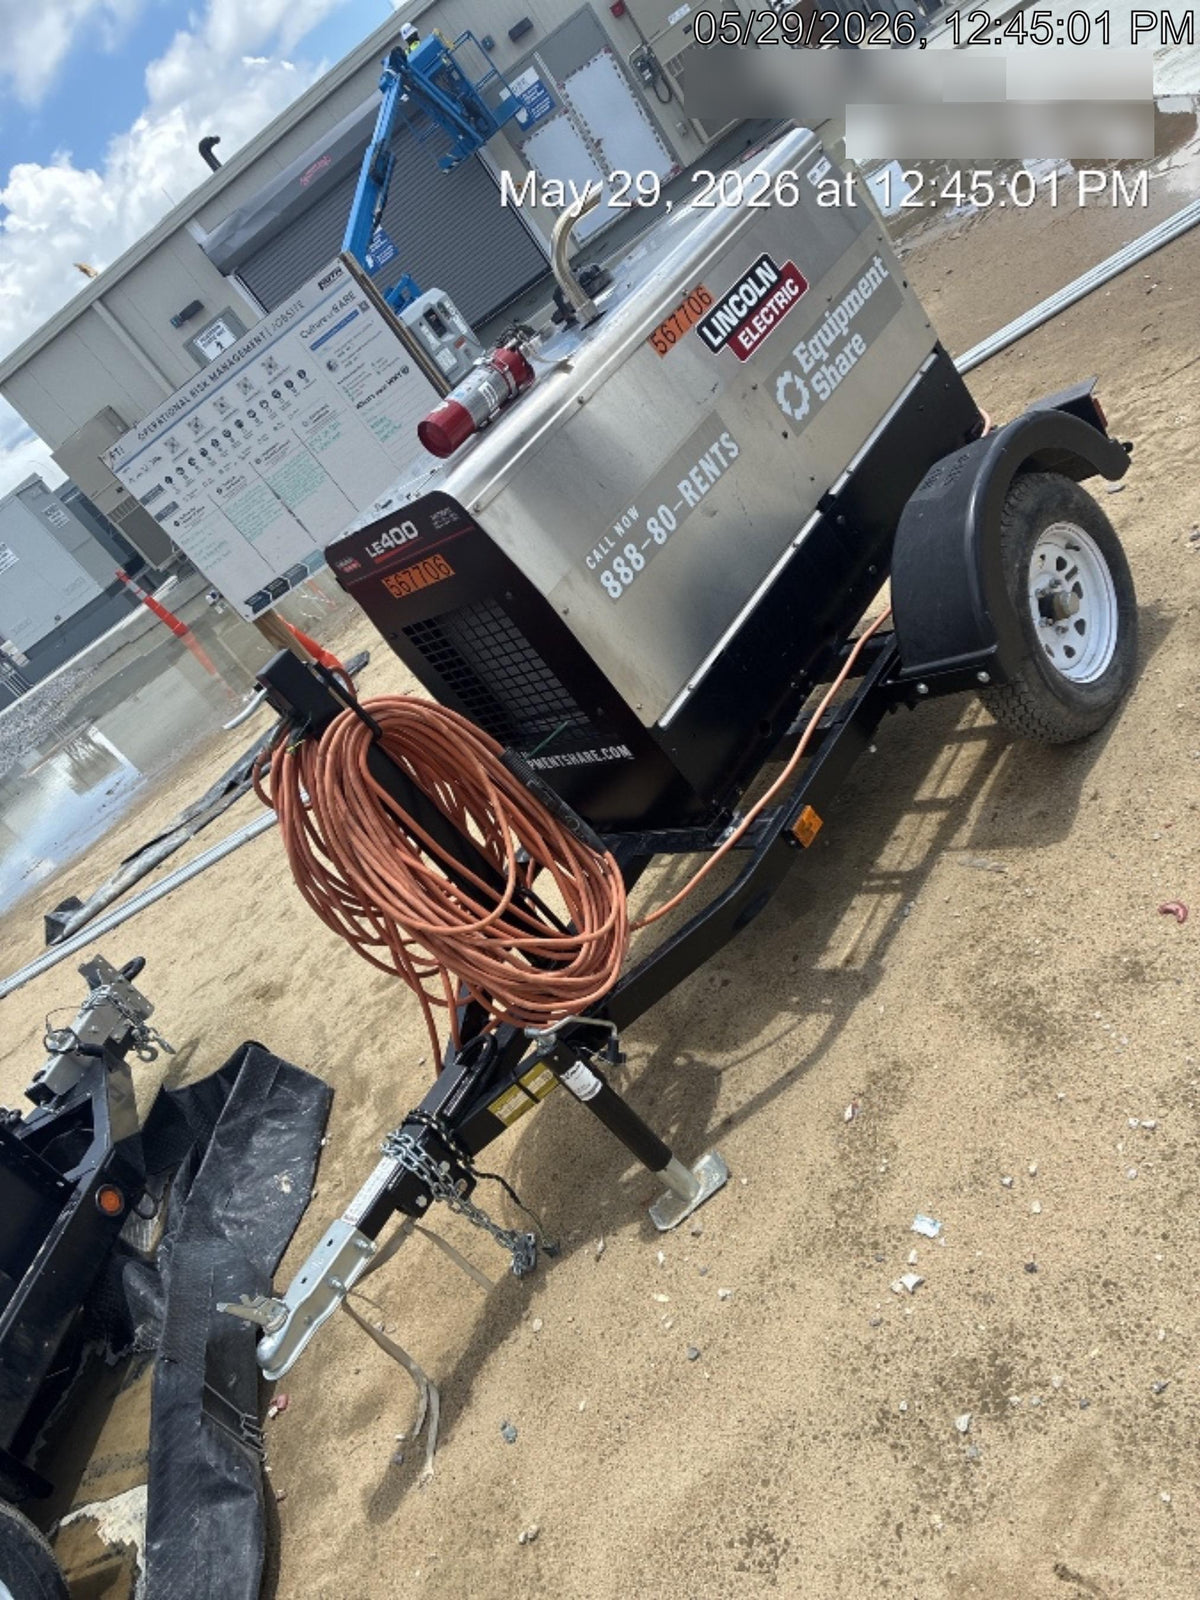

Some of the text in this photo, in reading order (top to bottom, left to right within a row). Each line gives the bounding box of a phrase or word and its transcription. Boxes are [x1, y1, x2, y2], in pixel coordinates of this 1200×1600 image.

[651, 287, 712, 354] 567706
[702, 261, 779, 348] LINCOLN
[738, 278, 800, 350] ELECTRIC
[792, 255, 890, 374] Equipment
[208, 331, 267, 382] MANAGEMENT
[810, 332, 867, 401] Share
[365, 520, 419, 558] LE400
[585, 505, 640, 570] CALL NOW
[600, 432, 740, 598] 888-80-RENTS
[384, 555, 452, 597] 567706
[525, 744, 633, 770] PMENTSHARE.COM
